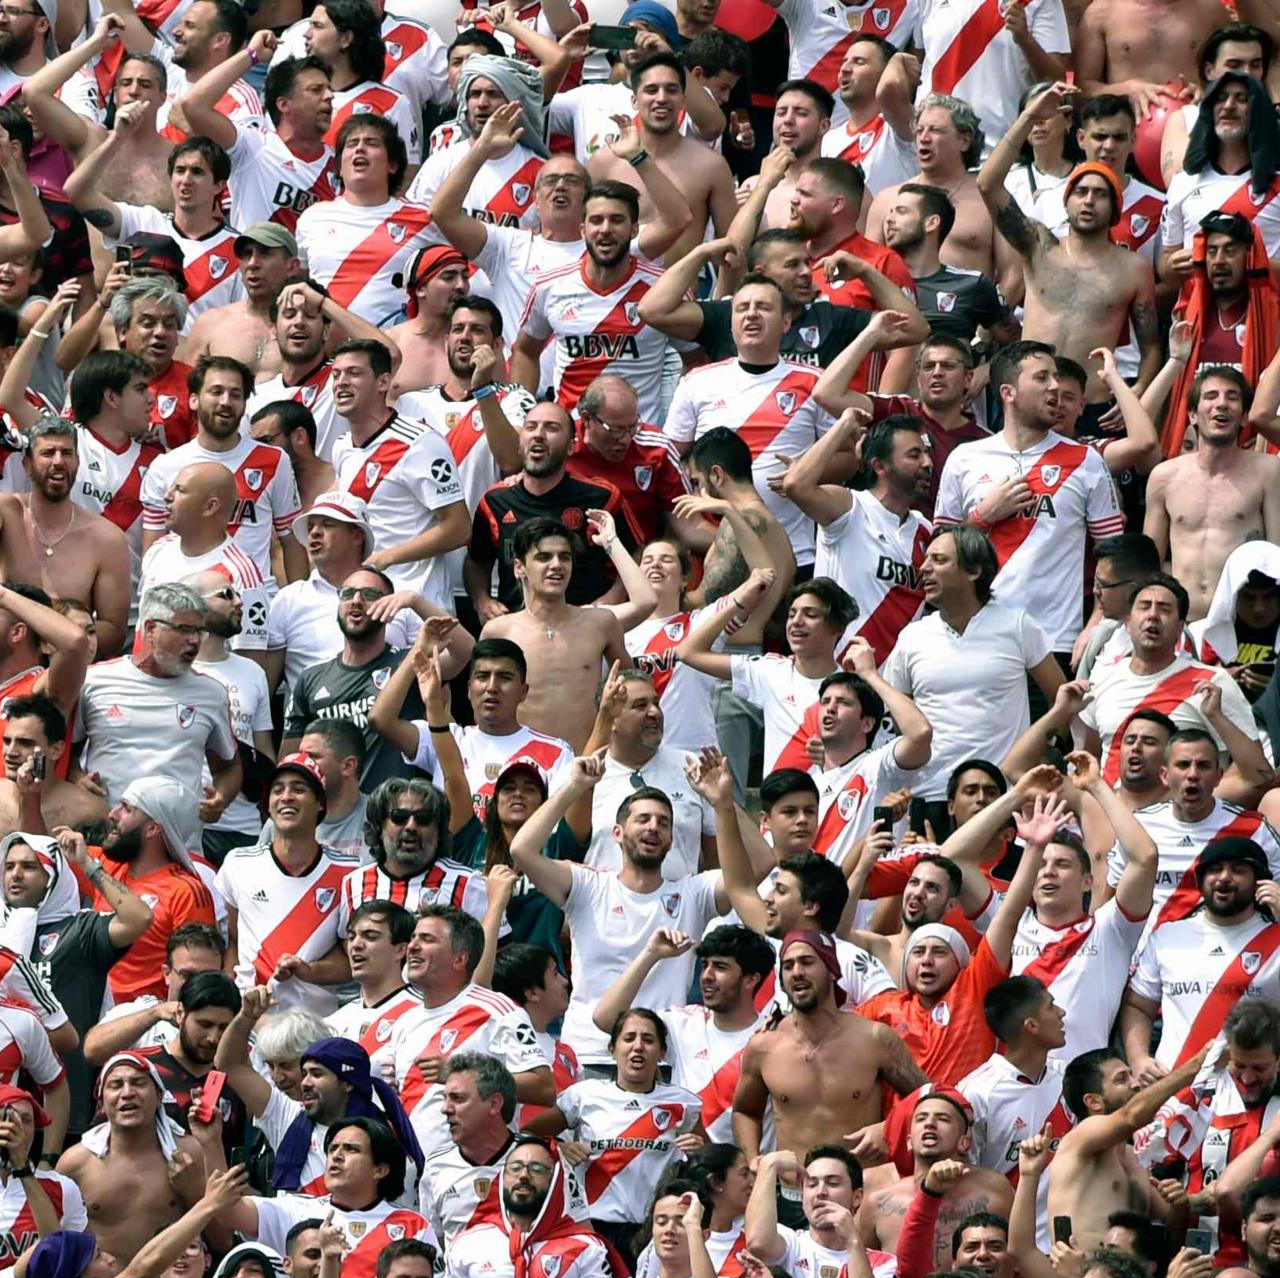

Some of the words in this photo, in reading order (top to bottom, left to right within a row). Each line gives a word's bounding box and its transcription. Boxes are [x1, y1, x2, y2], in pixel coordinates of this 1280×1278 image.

[565, 334, 639, 359] BBVA
[876, 556, 924, 590] BBV
[316, 694, 376, 720] TURKIS
[590, 1138, 669, 1152] PETROBRAS
